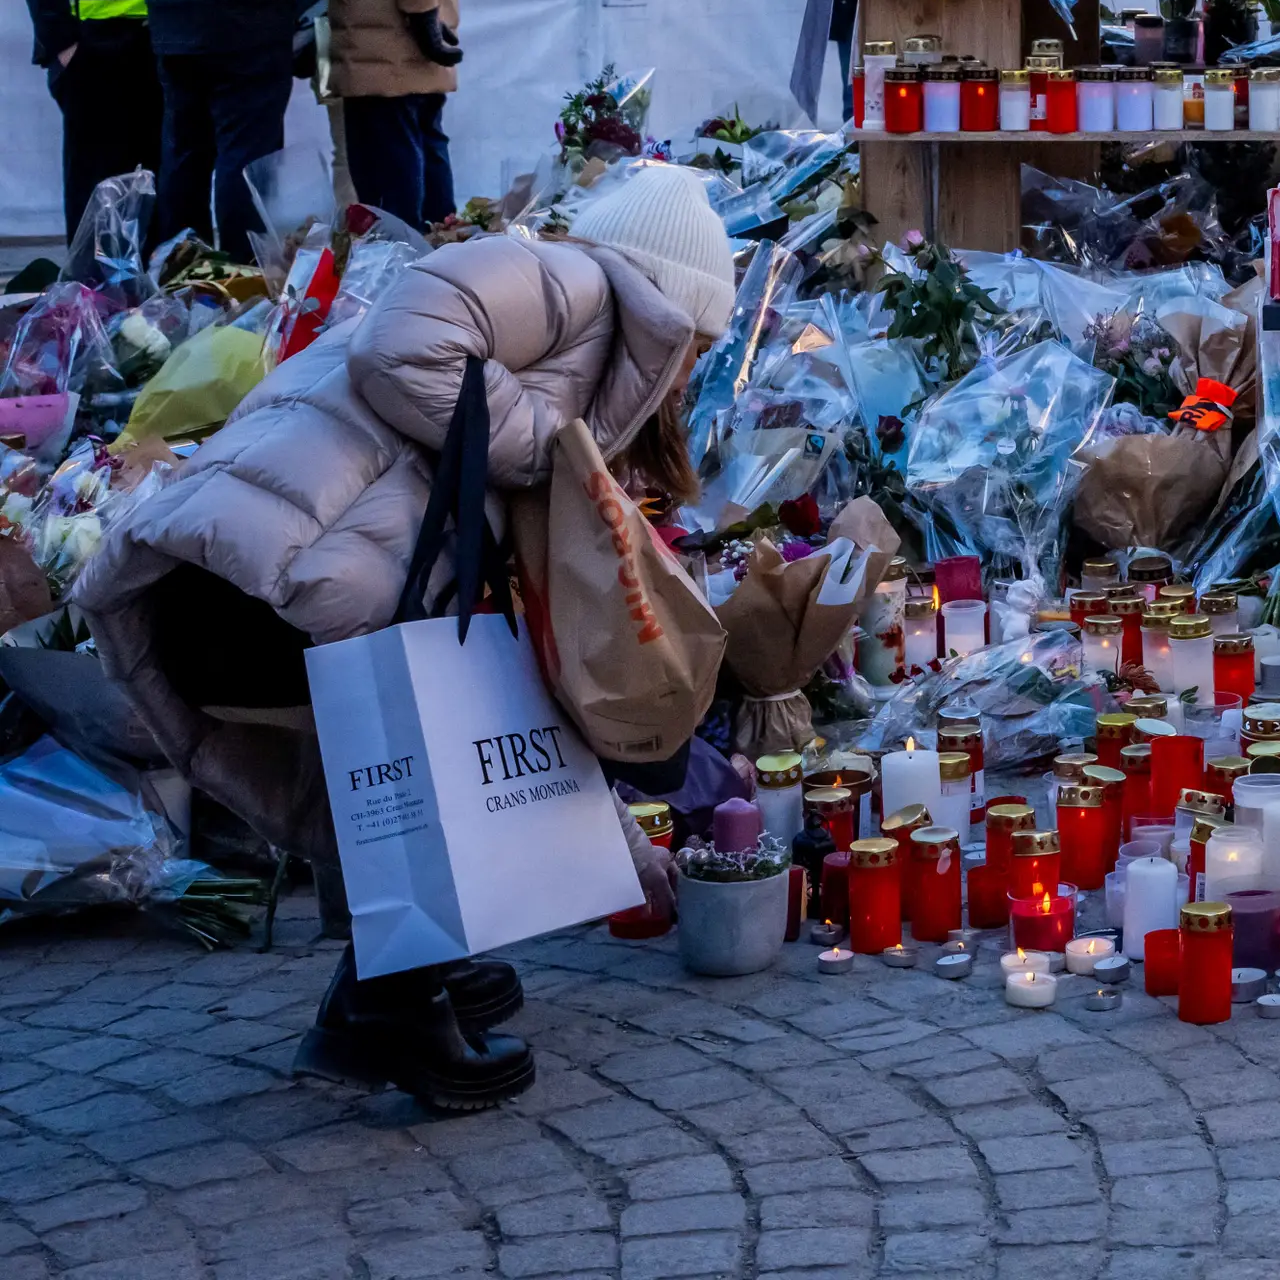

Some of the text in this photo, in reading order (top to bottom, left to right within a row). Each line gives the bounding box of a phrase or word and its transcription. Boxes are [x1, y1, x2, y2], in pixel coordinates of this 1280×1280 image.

[472, 725, 568, 786] FIRST
[348, 755, 414, 792] FIRST
[366, 797, 382, 807] Rue
[383, 795, 393, 803] du
[486, 778, 581, 813] CRANS MONTANA
[350, 807, 385, 822] CH-3963
